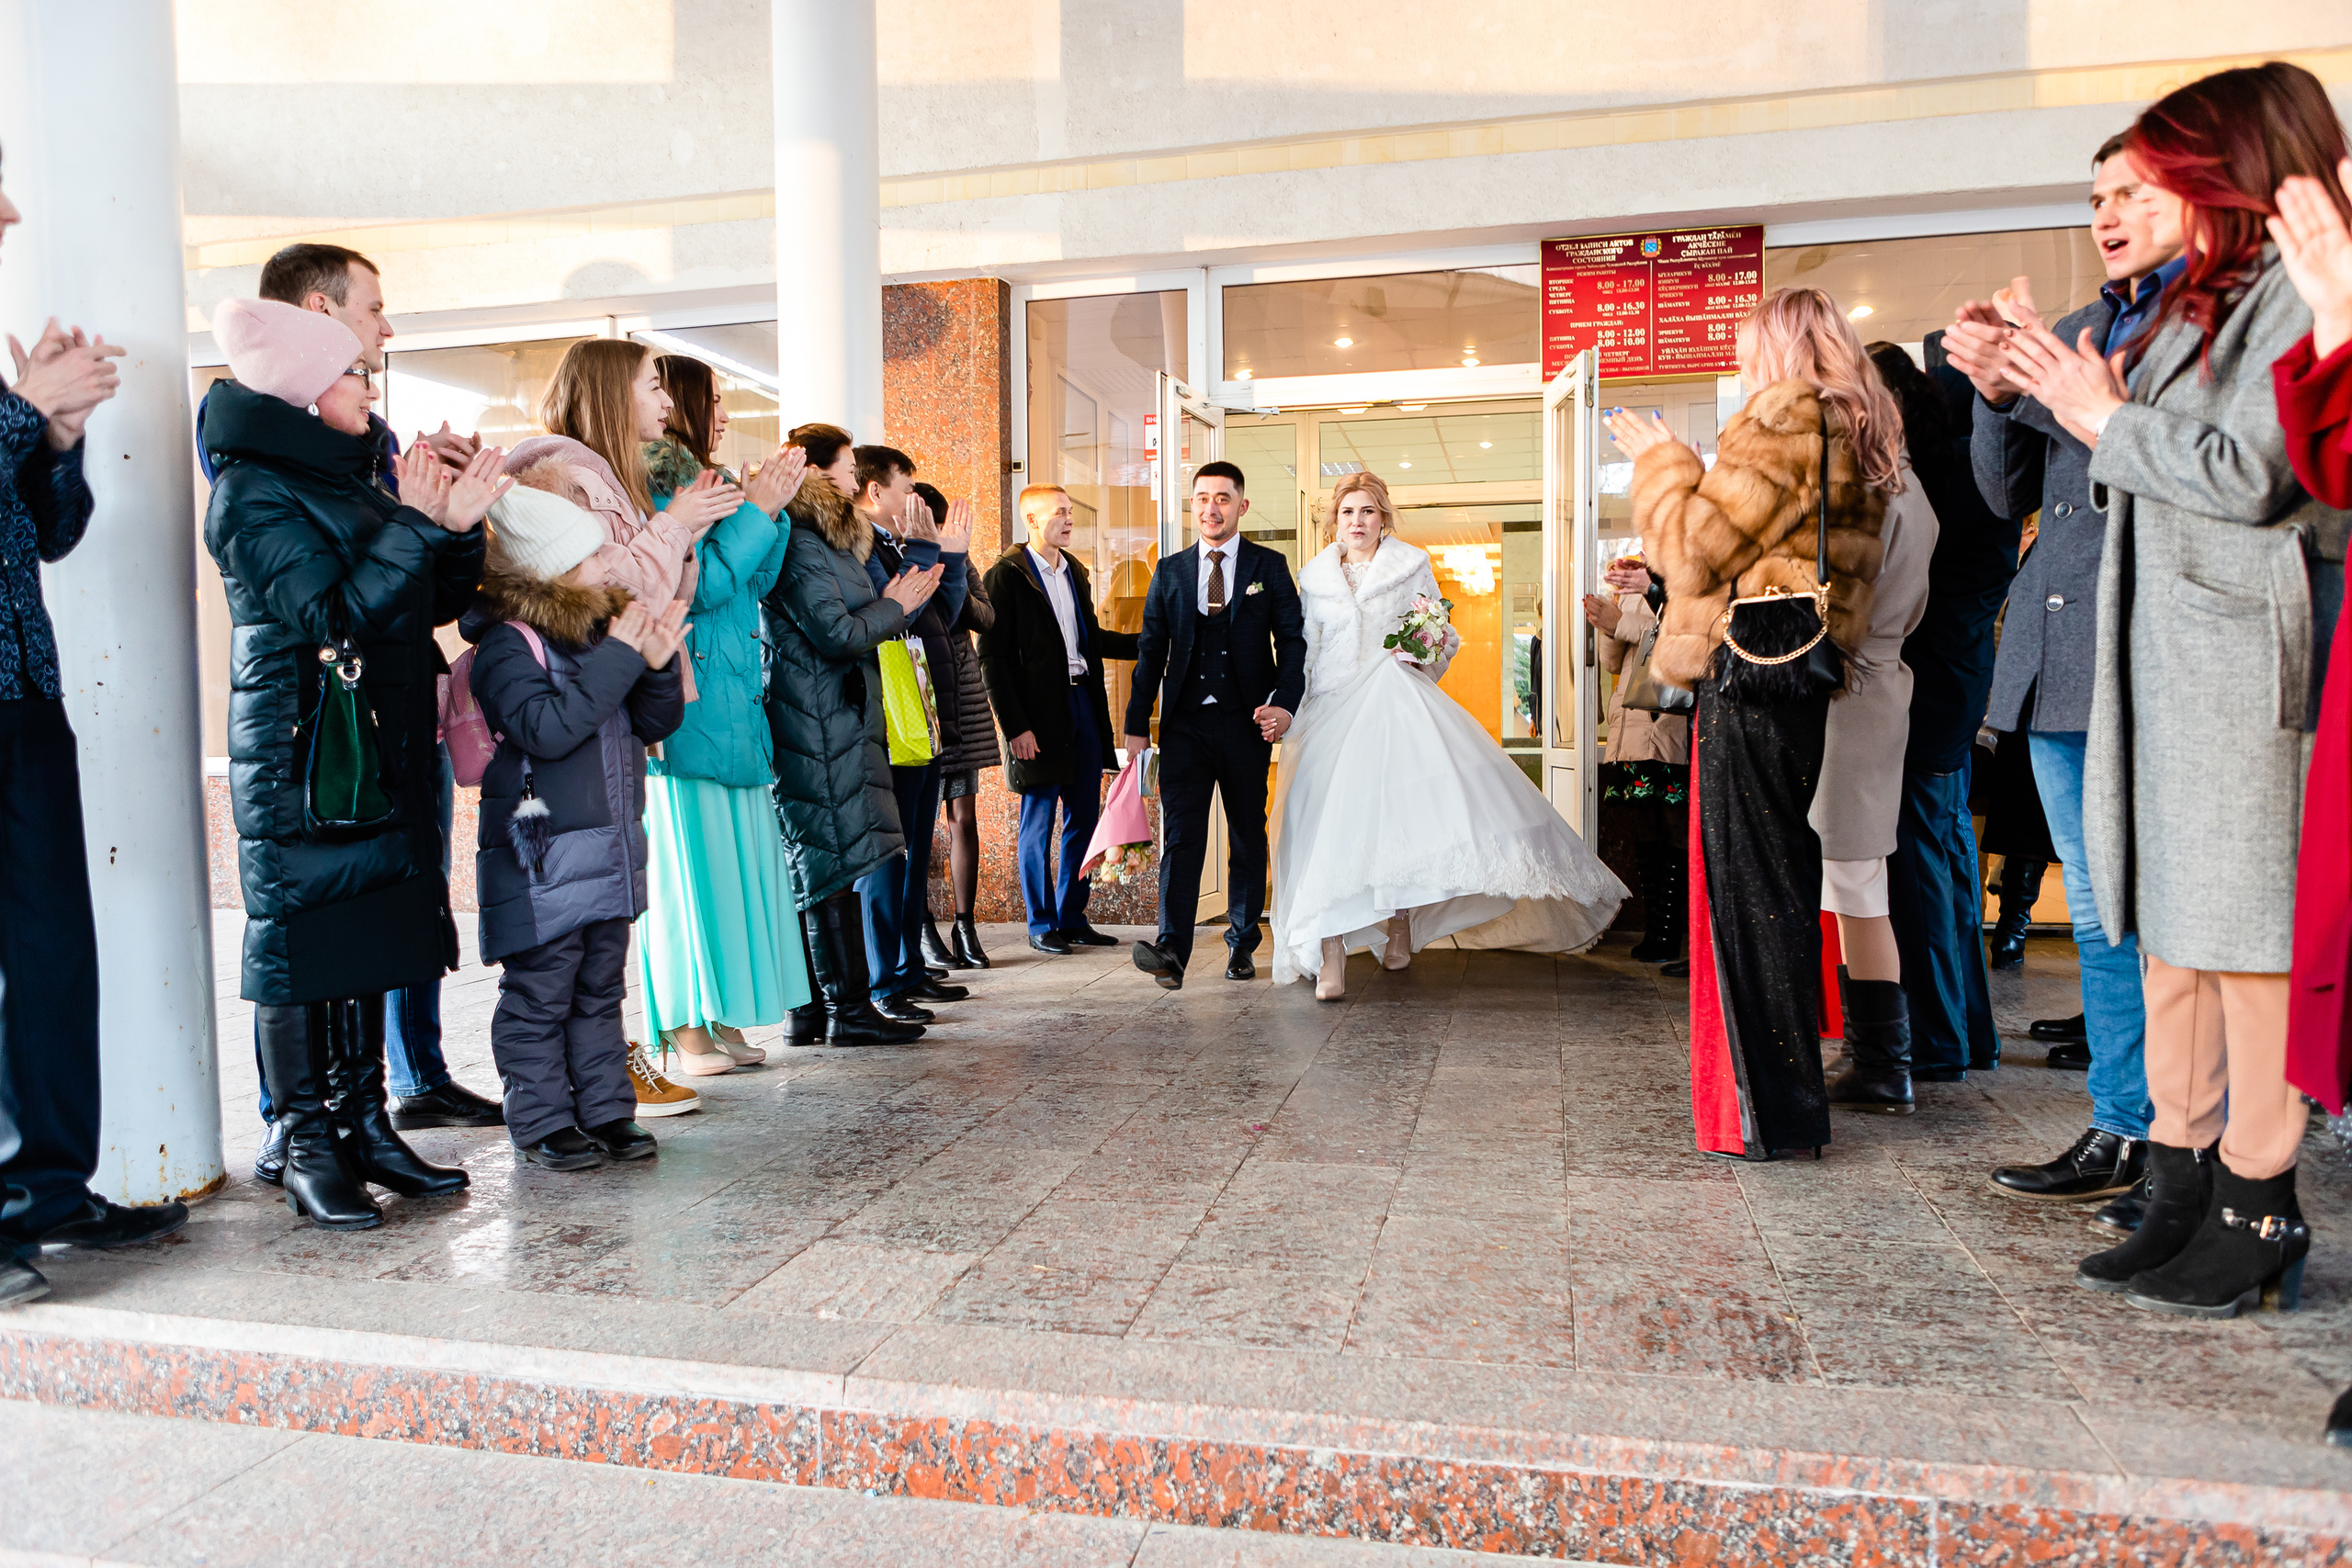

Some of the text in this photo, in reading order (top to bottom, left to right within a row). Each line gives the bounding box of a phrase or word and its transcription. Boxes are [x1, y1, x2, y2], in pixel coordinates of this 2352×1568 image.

[1672, 234, 1706, 243] ГРАЖДАН
[1579, 242, 1608, 250] ЗАПИСИ
[1609, 239, 1634, 247] АКТОВ
[1566, 247, 1623, 257] ГРАЖДАНСКОГО
[1572, 254, 1616, 264] СОСТОЯНИЯ
[1708, 274, 1726, 283] 8.00
[1735, 271, 1758, 280] 17.00
[1597, 281, 1615, 290] 8.00
[1623, 278, 1645, 288] 17.00
[1708, 296, 1726, 306] 8.00
[1735, 294, 1758, 303] 16.30
[1597, 303, 1615, 312] 8.00
[1623, 301, 1645, 310] 16.30
[1597, 330, 1615, 339] 8.00
[1623, 328, 1645, 337] 12.00
[1708, 323, 1726, 333] 8.00
[1597, 339, 1615, 348] 8.00
[1623, 337, 1645, 346] 10.00
[1708, 333, 1726, 342] 8.00
